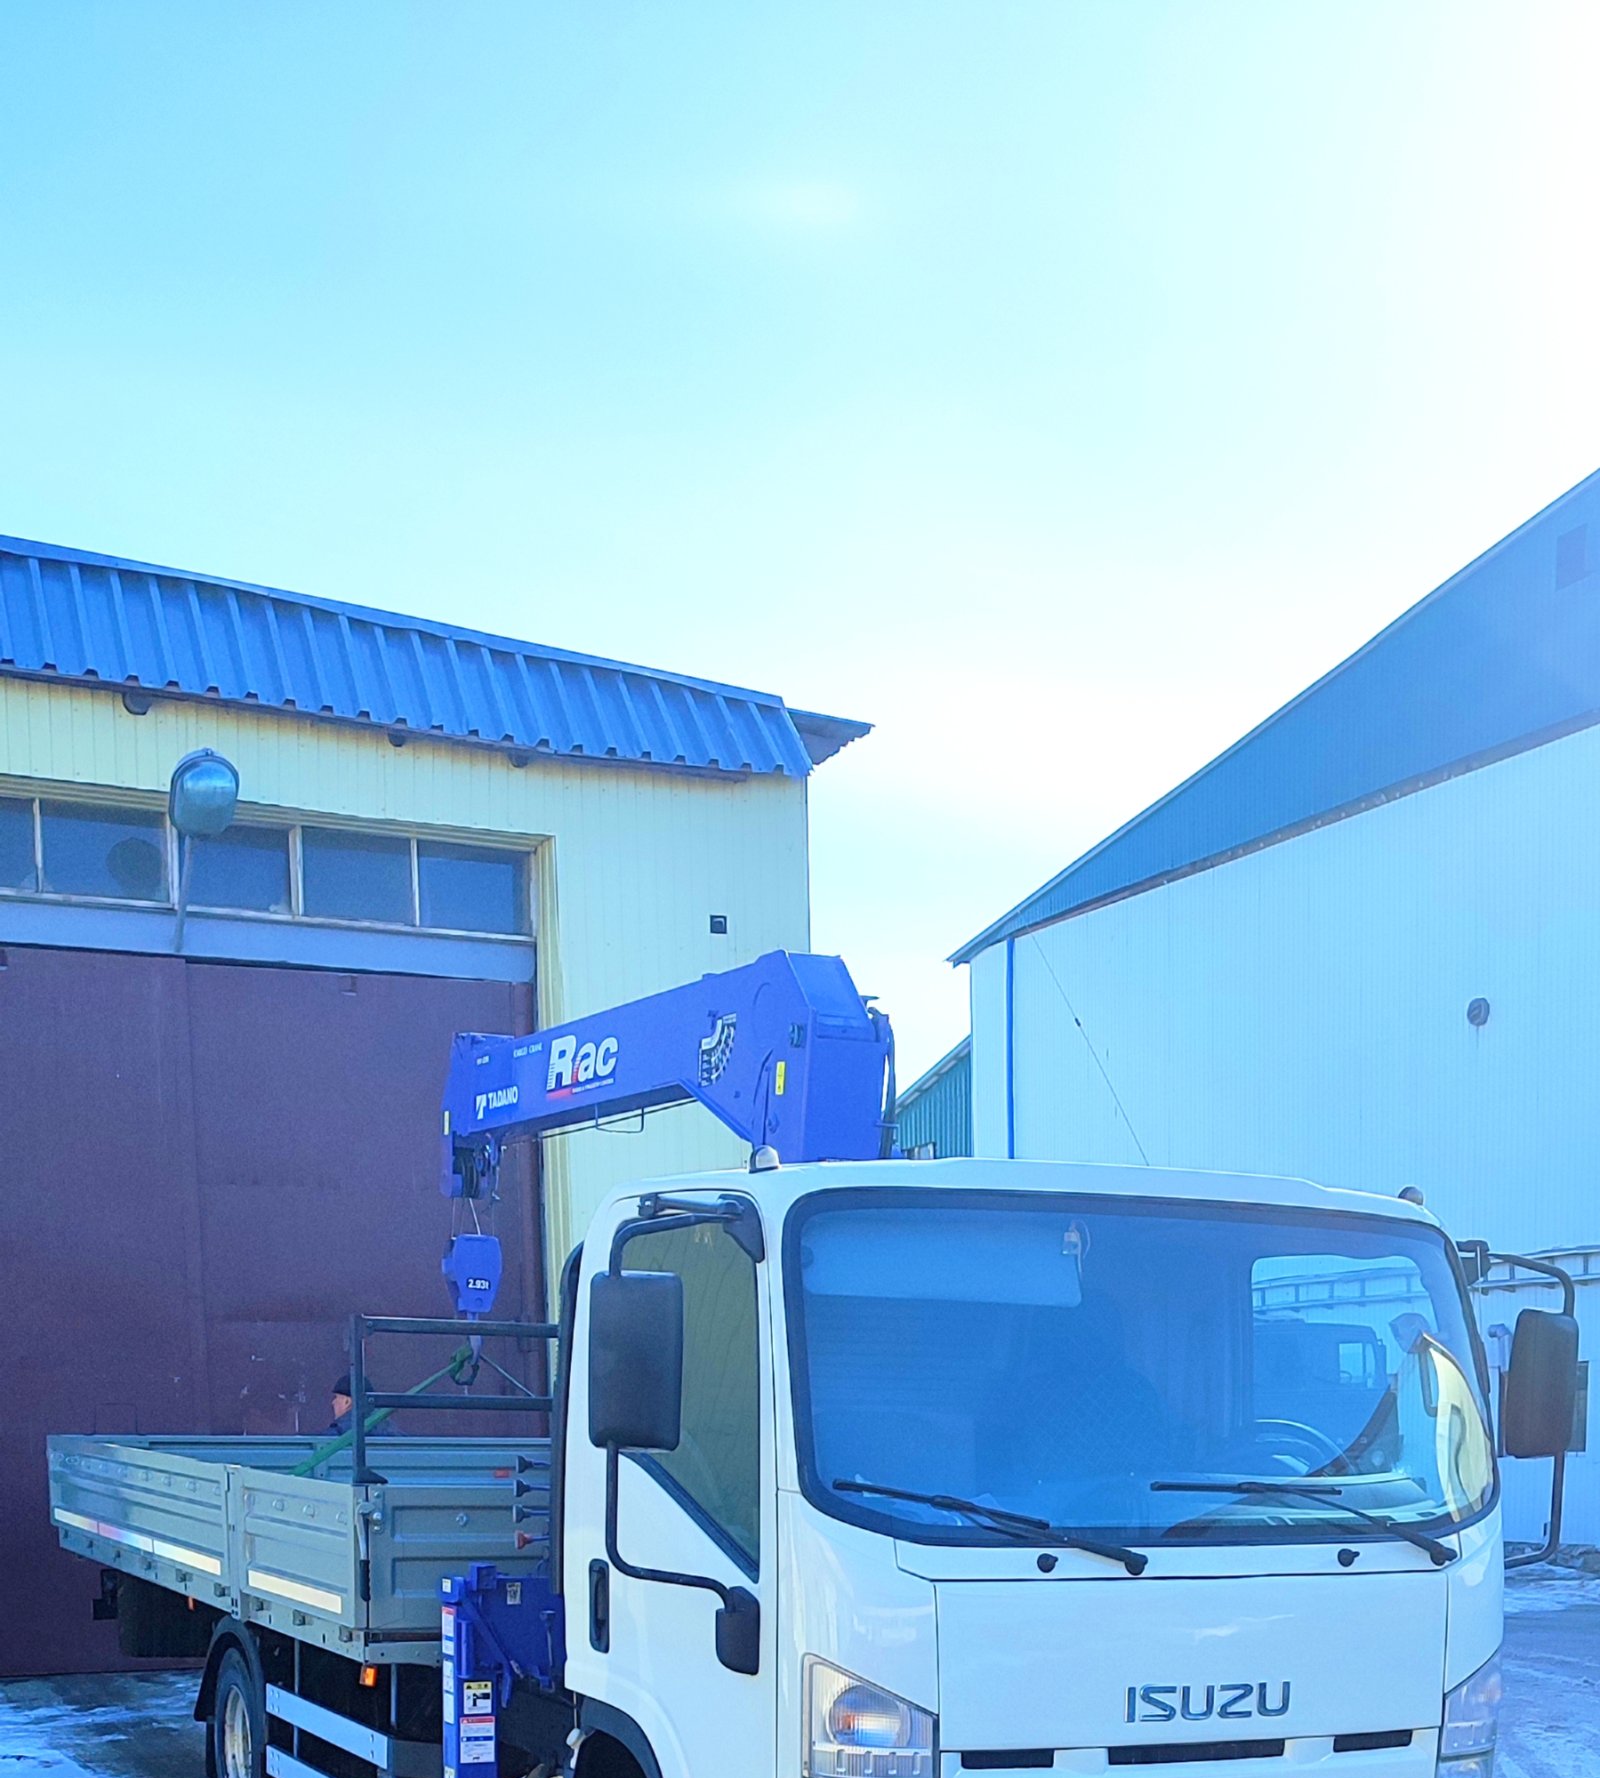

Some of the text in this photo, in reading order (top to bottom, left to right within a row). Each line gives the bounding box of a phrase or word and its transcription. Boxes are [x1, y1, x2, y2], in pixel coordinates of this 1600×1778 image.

[546, 1034, 619, 1091] Rac
[487, 1085, 519, 1110] TADANO
[1124, 1681, 1291, 1723] ISUZU
